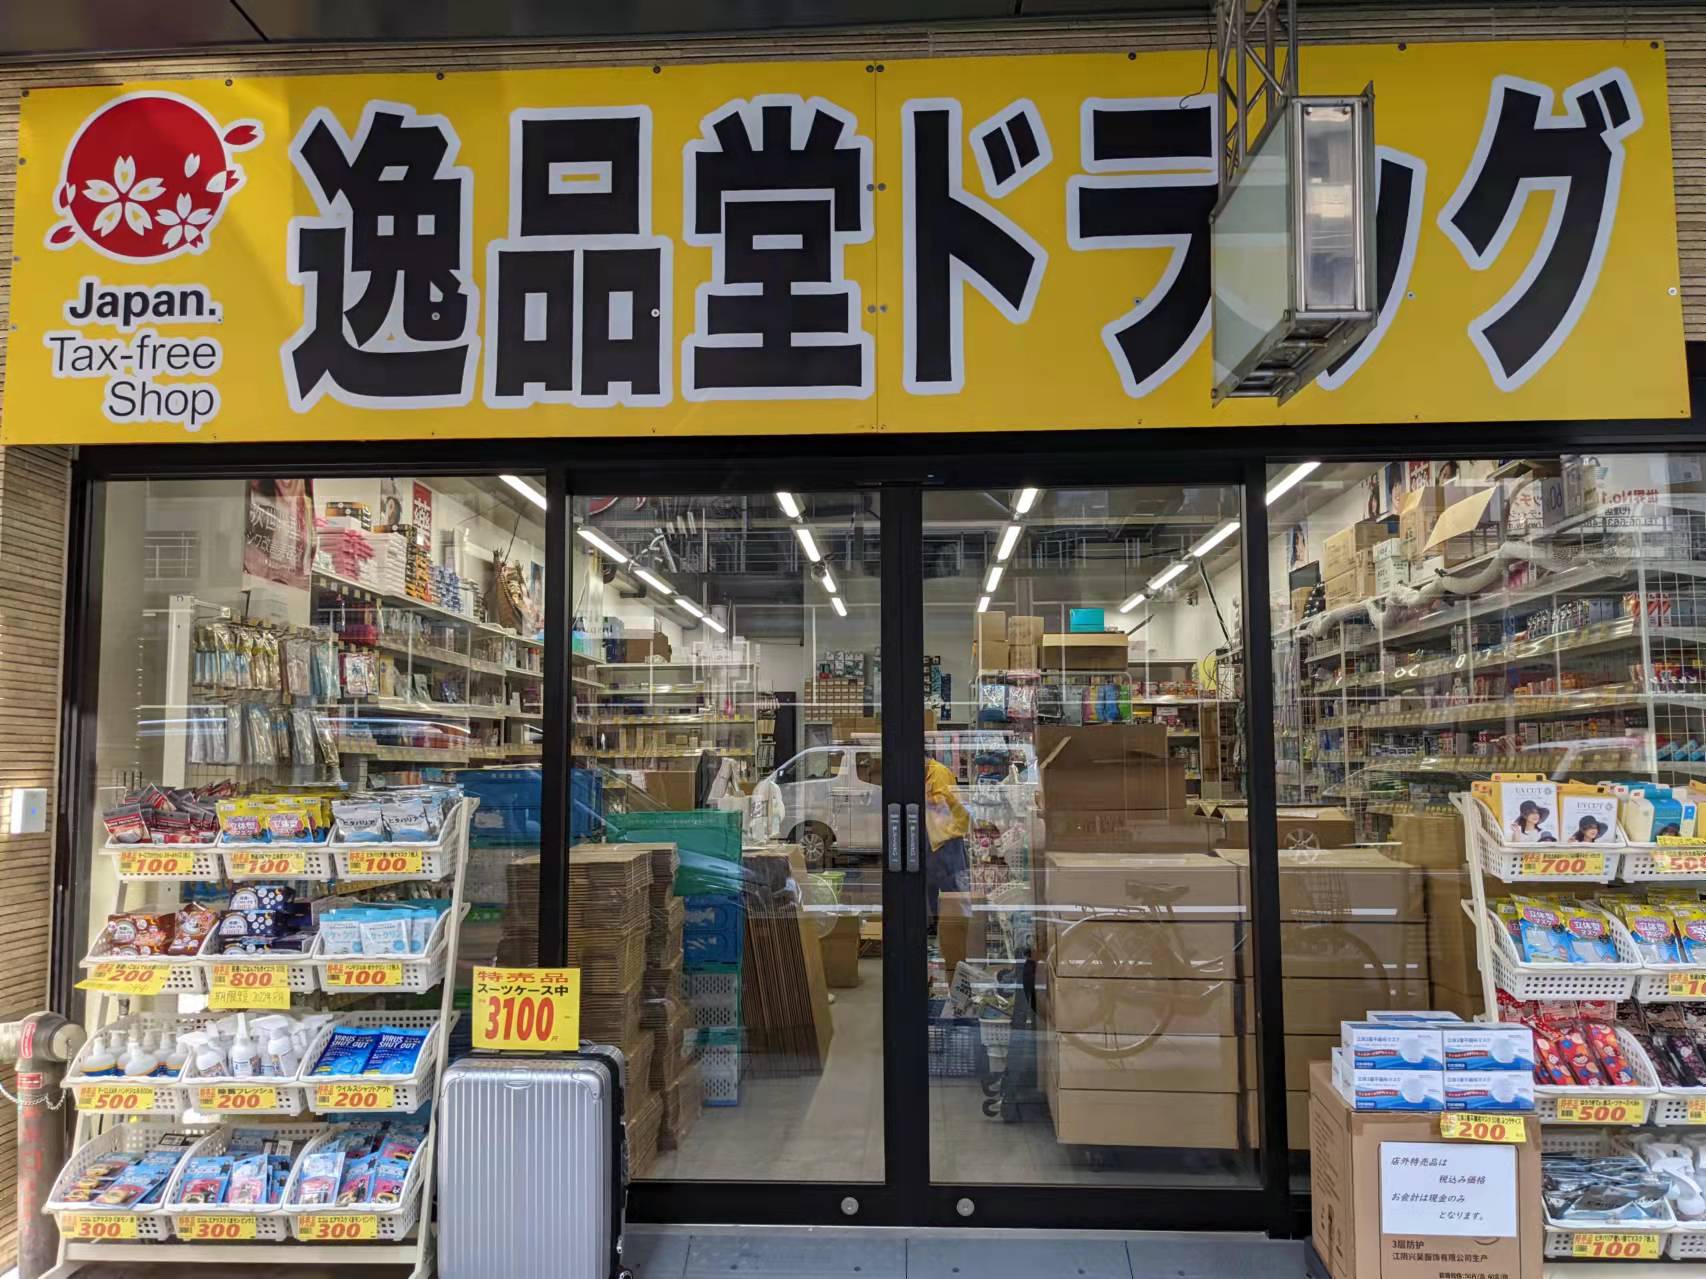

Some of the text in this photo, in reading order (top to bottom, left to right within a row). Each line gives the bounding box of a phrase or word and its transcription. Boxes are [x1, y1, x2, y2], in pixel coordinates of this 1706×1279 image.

[69, 282, 217, 325] Japan.
[50, 335, 216, 371] Tax-free
[108, 380, 214, 425] Shop
[136, 858, 177, 872] 100
[249, 859, 289, 873] 100
[366, 857, 407, 872] 100
[1540, 858, 1586, 873] 700
[110, 970, 154, 982] 200
[230, 973, 272, 986] 800
[344, 970, 386, 984] 100
[477, 971, 568, 984] 特売品
[477, 984, 569, 997] スーツケース中
[485, 996, 555, 1042] 3100
[334, 1034, 355, 1043] VIRUS
[378, 1041, 398, 1049] SHUT
[381, 1034, 403, 1043] VIRUS
[96, 1094, 138, 1108] 500
[217, 1094, 260, 1108] 200
[335, 1092, 378, 1107] 200
[1578, 1106, 1626, 1121] 500
[1459, 1121, 1506, 1140] 200
[1391, 1157, 1448, 1167] 店外特売品は
[1439, 1174, 1486, 1185] 税込み価格
[1391, 1192, 1465, 1203] お会計は現金のみ
[1439, 1211, 1484, 1221] となります。
[79, 1223, 121, 1236] 300
[196, 1223, 241, 1238] 300
[316, 1223, 361, 1238] 300
[1592, 1242, 1641, 1257] 100
